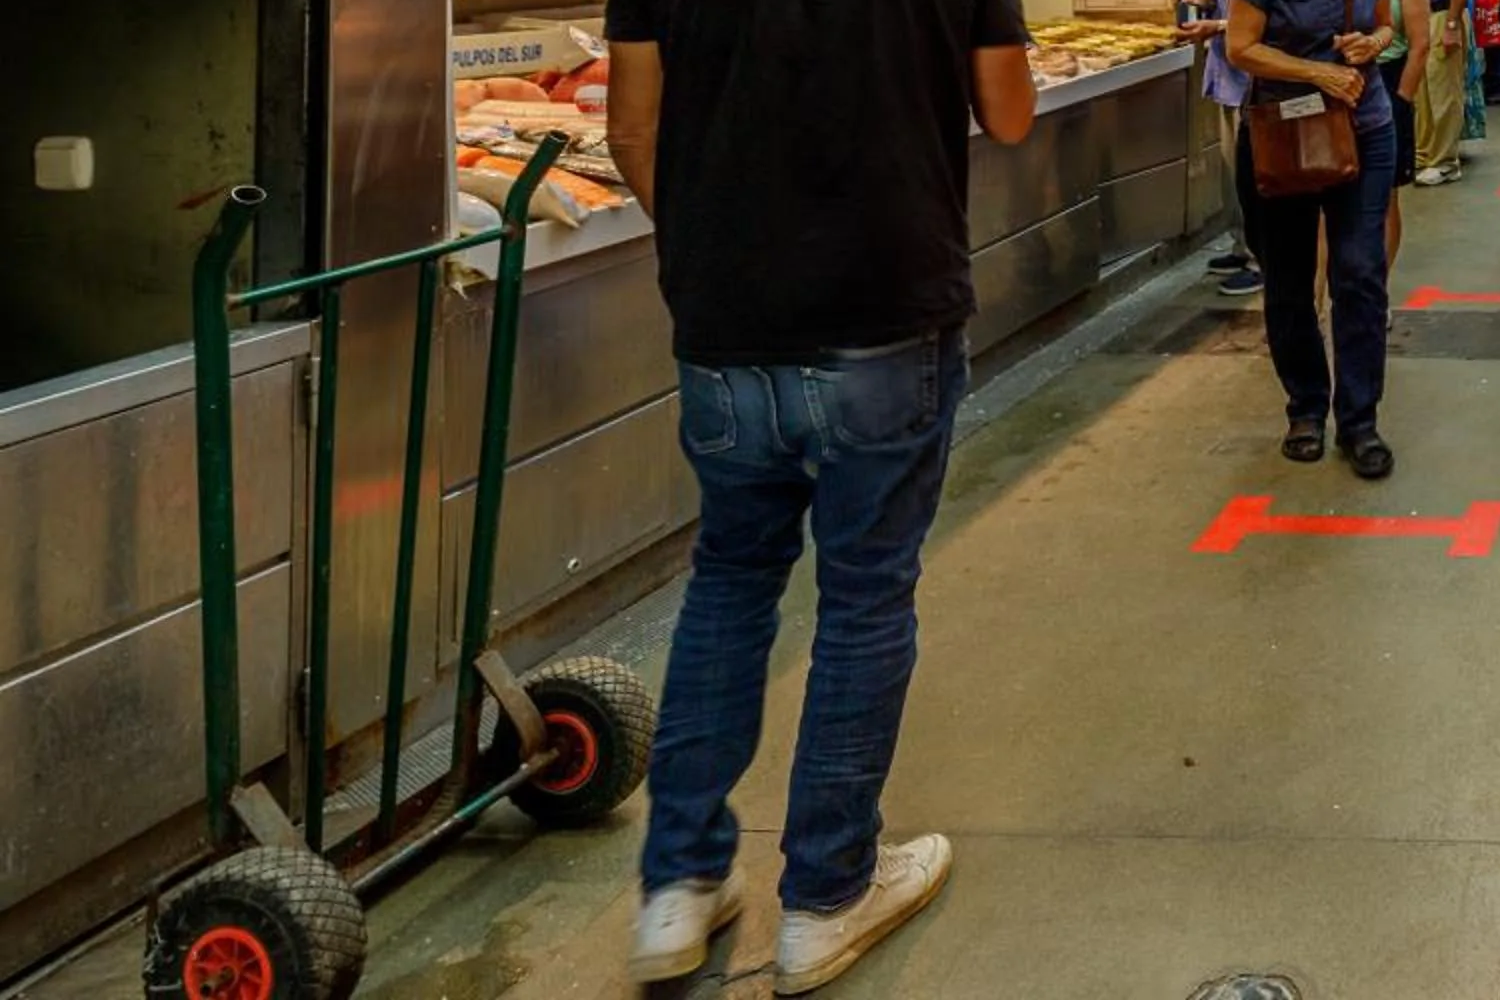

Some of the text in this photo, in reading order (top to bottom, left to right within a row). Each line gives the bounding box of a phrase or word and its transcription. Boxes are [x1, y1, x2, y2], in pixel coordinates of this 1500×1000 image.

[453, 43, 543, 67] PULPOS DEL SUR
